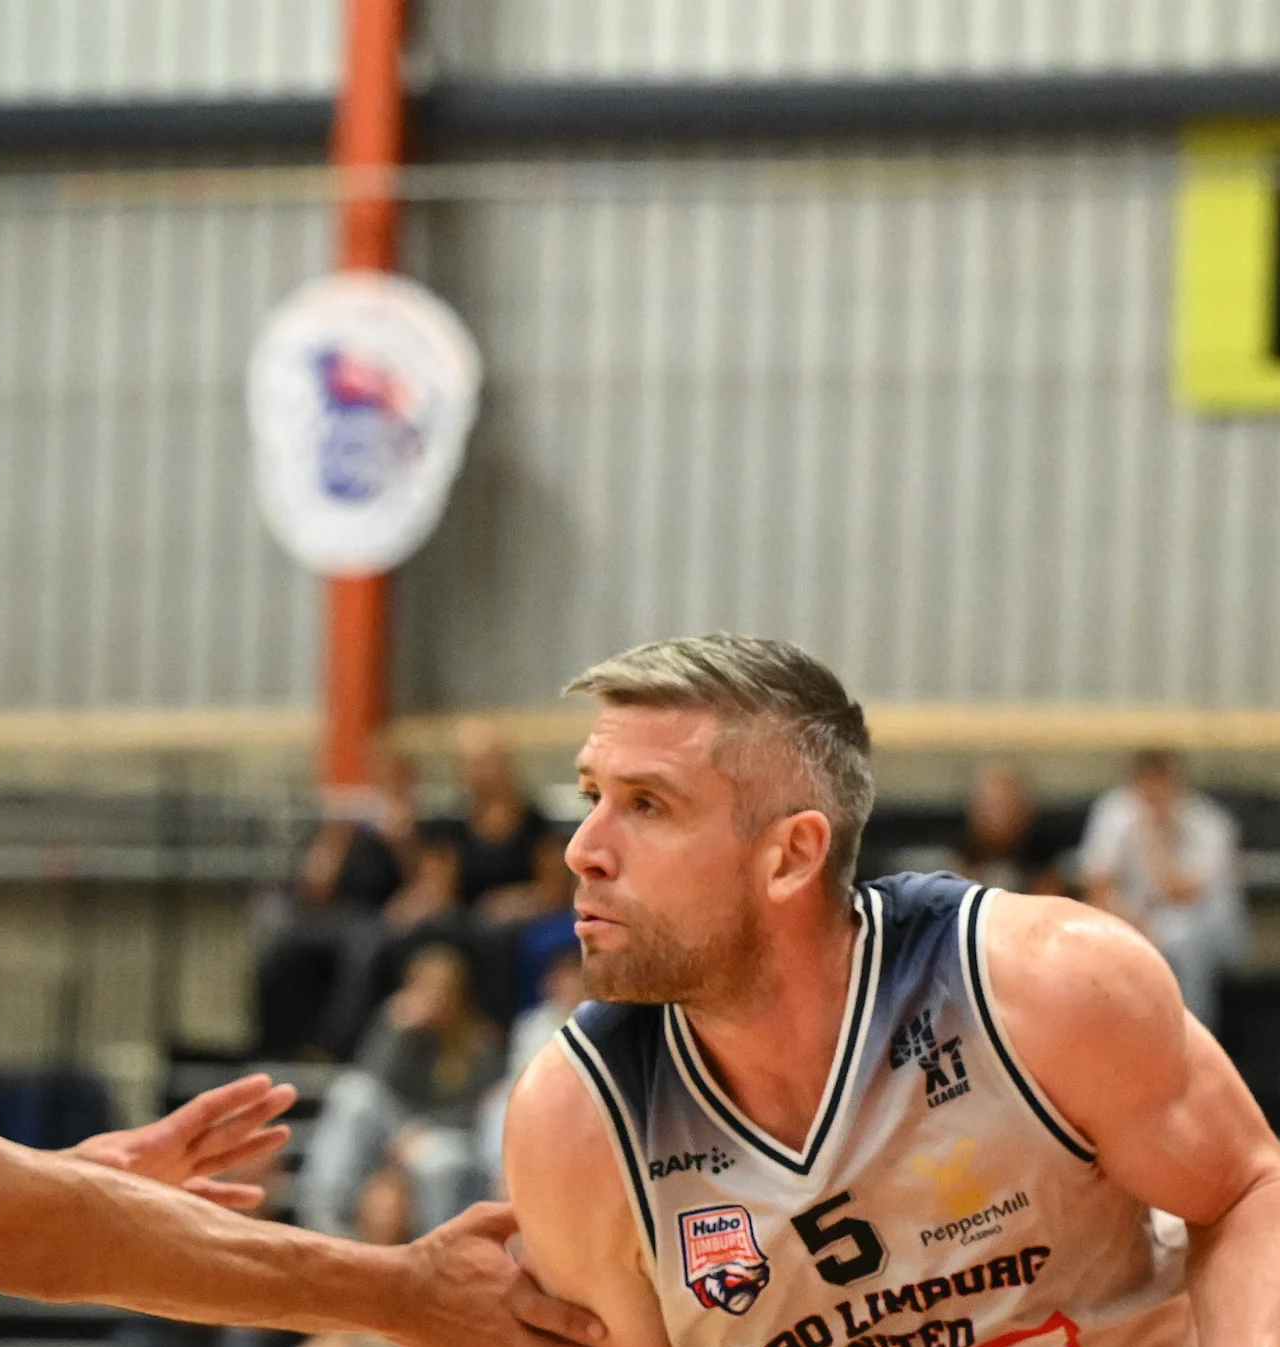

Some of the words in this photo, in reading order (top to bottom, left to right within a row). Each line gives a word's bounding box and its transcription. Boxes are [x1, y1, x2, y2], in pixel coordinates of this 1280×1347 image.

[926, 1079, 972, 1109] LEAGUE
[693, 1216, 741, 1237] Hubo
[790, 1190, 884, 1287] 5
[920, 1191, 1030, 1247] PepperMill
